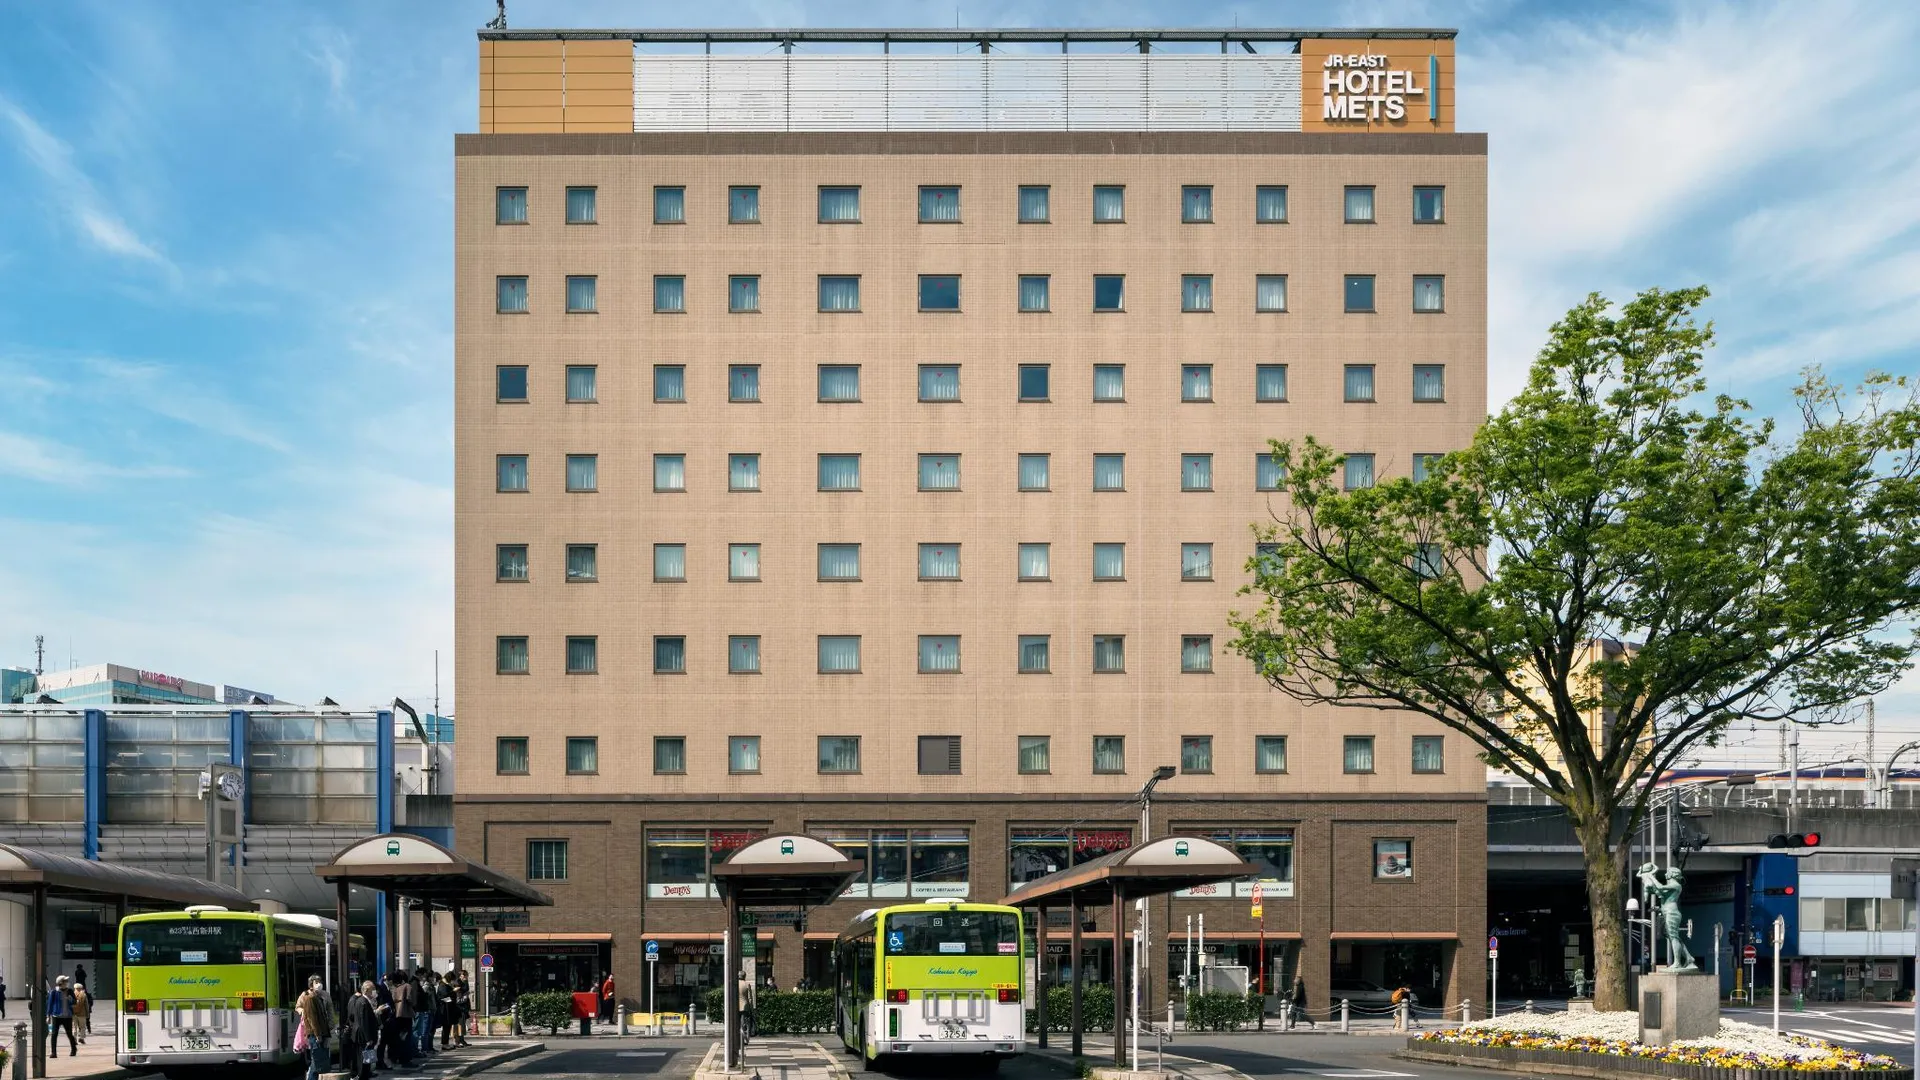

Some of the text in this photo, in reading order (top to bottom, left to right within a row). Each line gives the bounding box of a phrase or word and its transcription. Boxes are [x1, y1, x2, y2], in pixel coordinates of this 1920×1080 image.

[1324, 54, 1387, 68] JR-EAST
[1323, 70, 1424, 95] HOTEL
[1323, 95, 1405, 120] METS
[663, 885, 691, 896] Denny's
[464, 914, 472, 926] 2
[744, 913, 751, 925] 3
